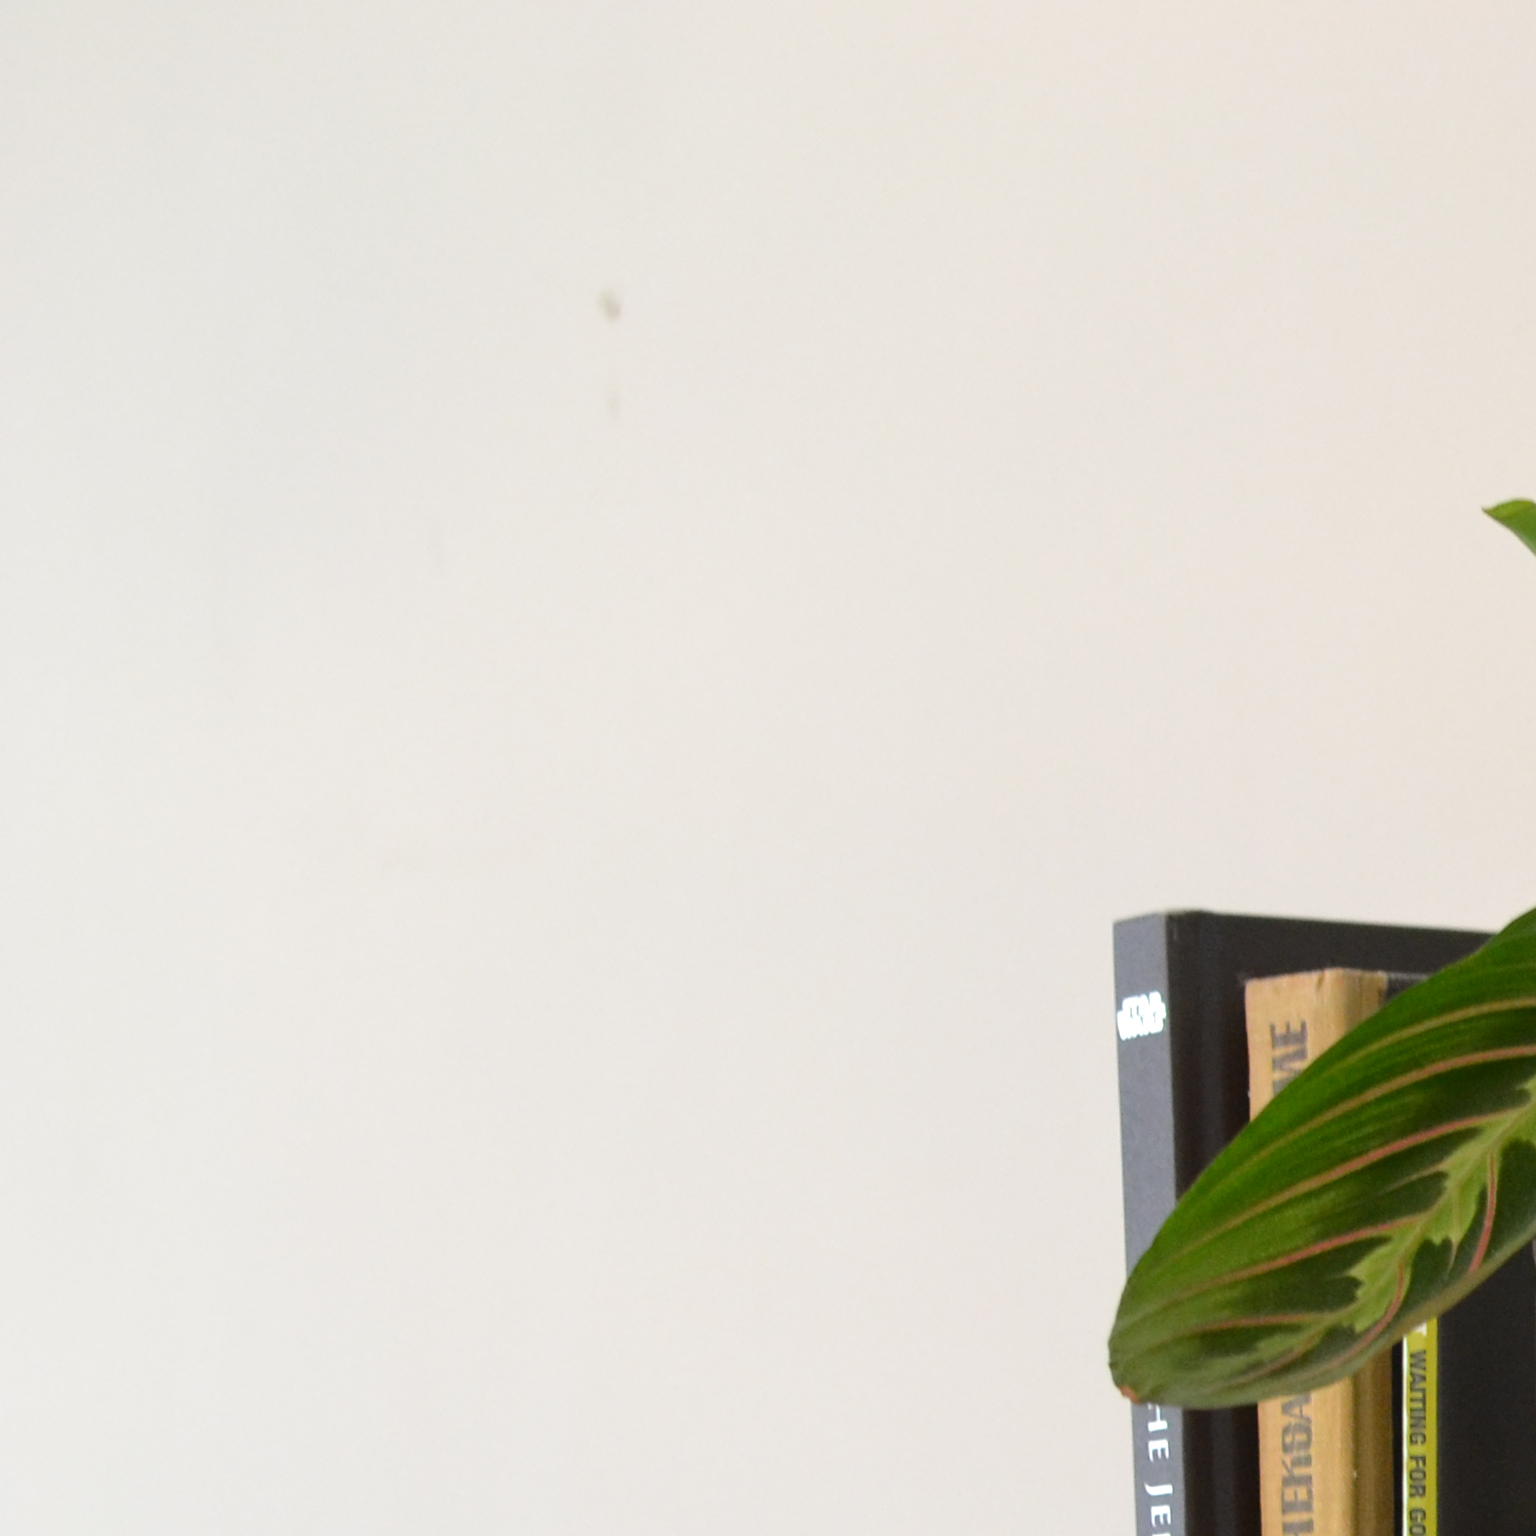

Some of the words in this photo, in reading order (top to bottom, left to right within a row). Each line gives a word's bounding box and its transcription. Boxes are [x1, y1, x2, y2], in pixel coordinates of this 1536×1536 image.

[1408, 1350, 1427, 1446] WAITING
[1147, 1402, 1170, 1462] HE
[1408, 1455, 1427, 1499] FOR
